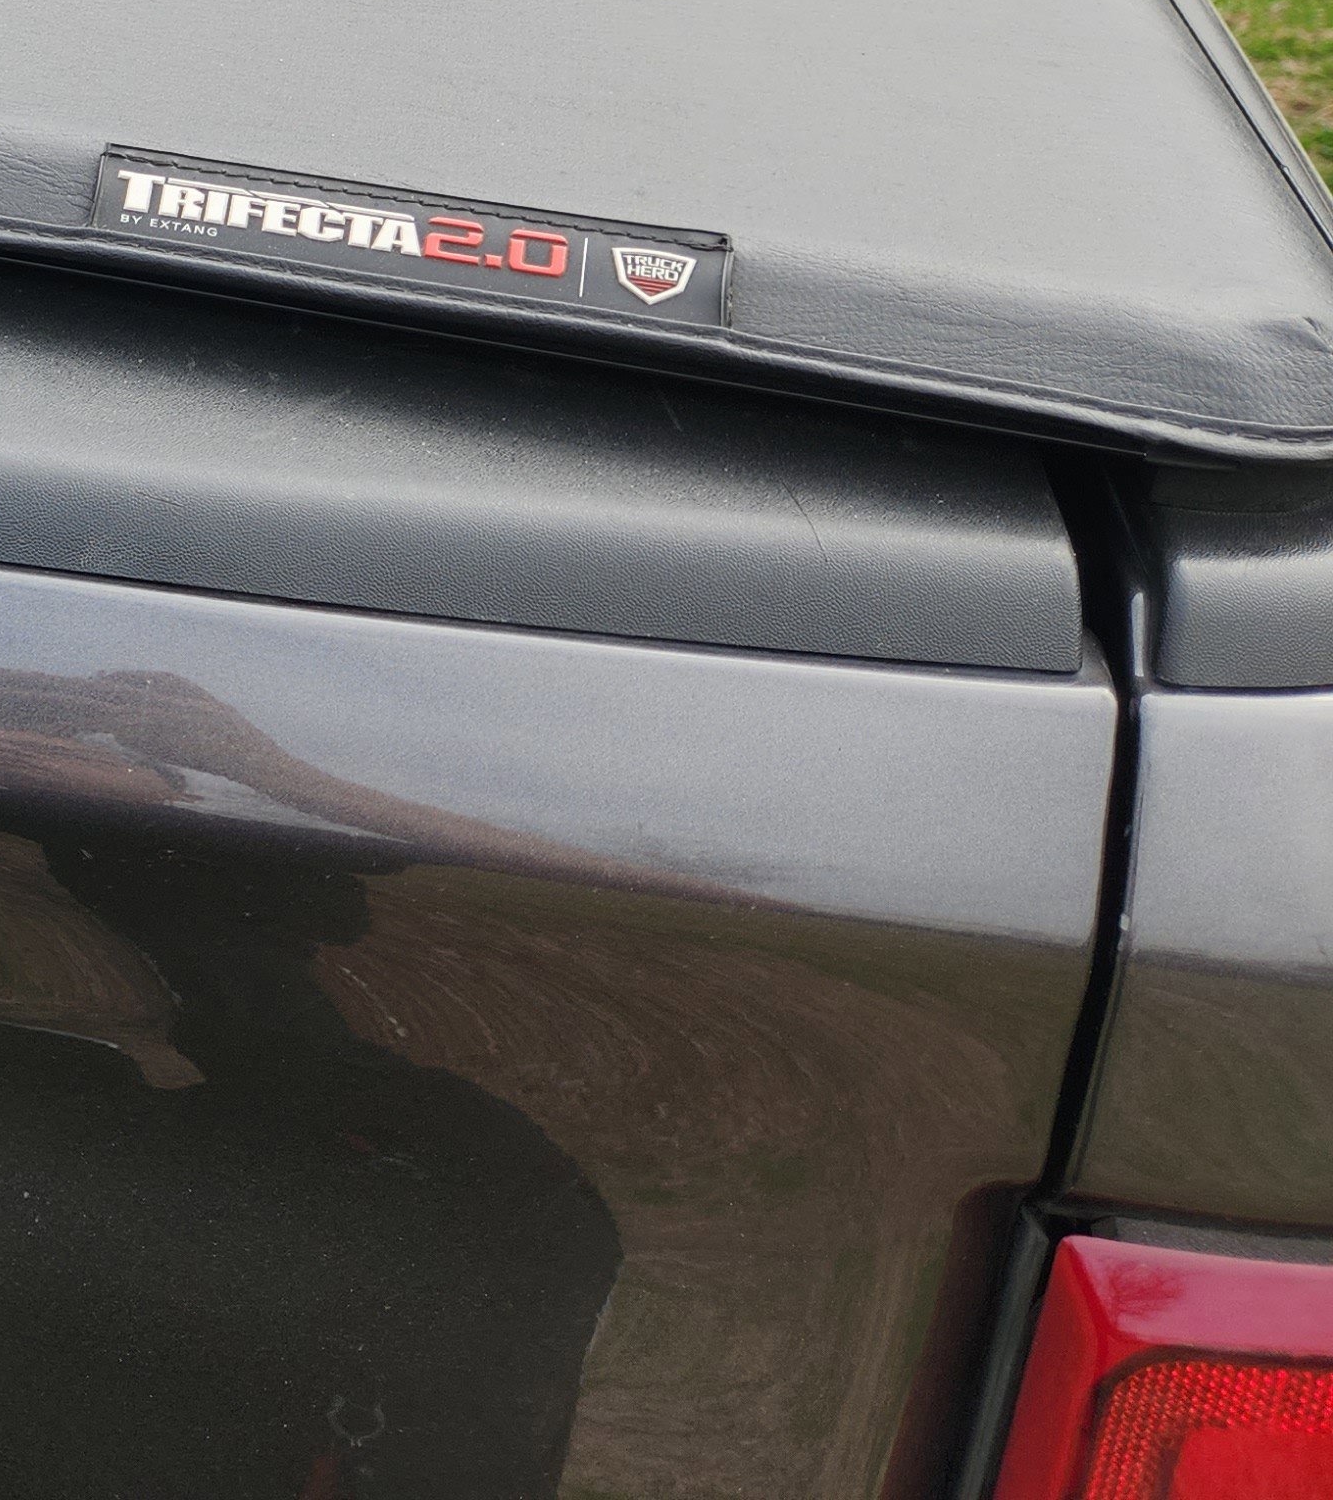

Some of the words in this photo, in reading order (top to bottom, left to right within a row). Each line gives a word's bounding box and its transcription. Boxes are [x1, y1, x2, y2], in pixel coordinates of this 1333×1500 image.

[118, 170, 422, 257] TRIFECTA
[424, 216, 569, 278] 2.0
[120, 214, 143, 225] BY
[149, 218, 218, 237] EXTANG
[622, 254, 684, 272] TRUCK
[627, 264, 679, 281] HERO
